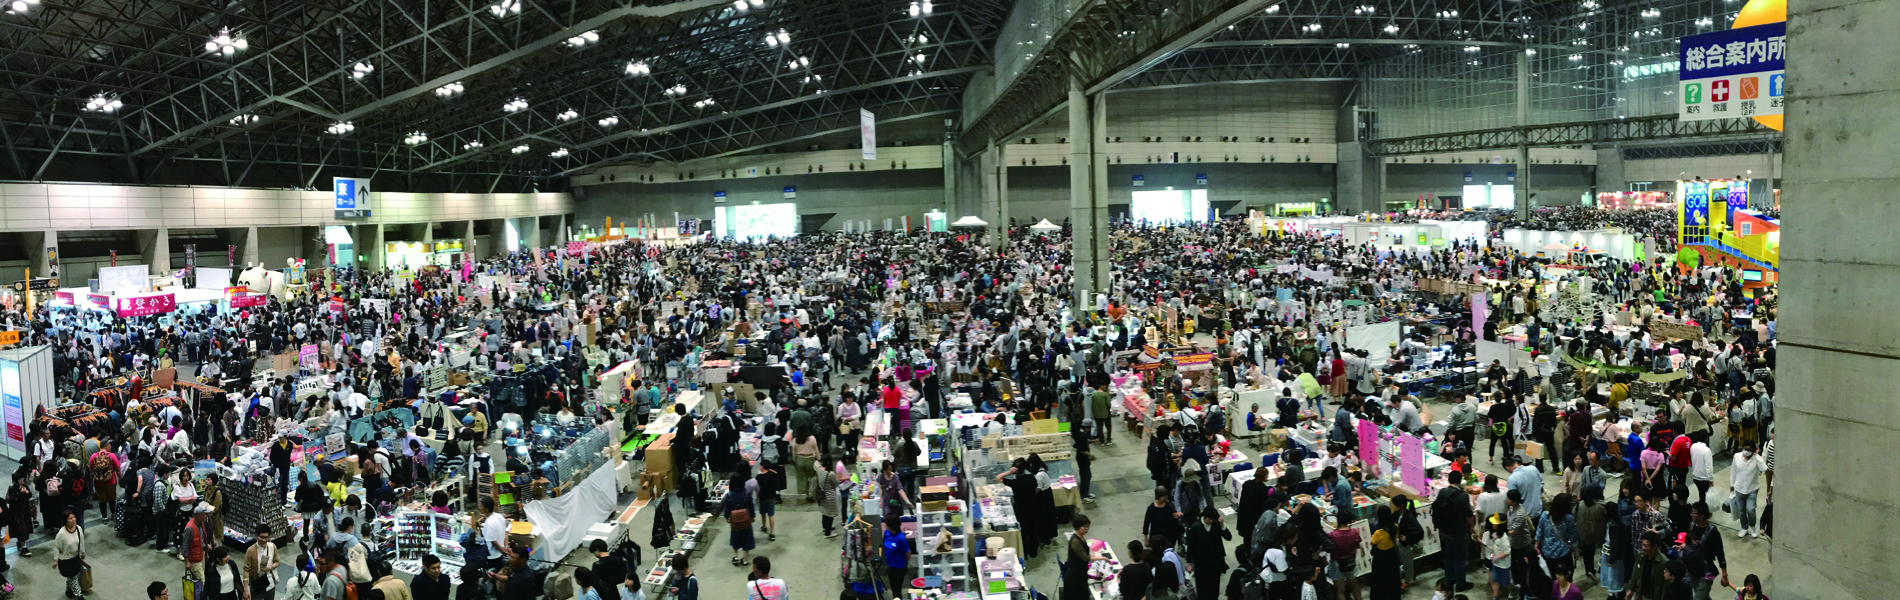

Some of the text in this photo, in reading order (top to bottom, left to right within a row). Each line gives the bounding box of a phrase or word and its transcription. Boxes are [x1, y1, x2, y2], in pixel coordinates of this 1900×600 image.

[1686, 36, 1785, 71] 総合案内所
[1686, 105, 1700, 114] 案内
[1713, 102, 1727, 112] 救護
[1741, 100, 1756, 110] 授乳
[337, 182, 348, 196] 東
[337, 197, 355, 206] ホール
[120, 295, 170, 310] 能登かき
